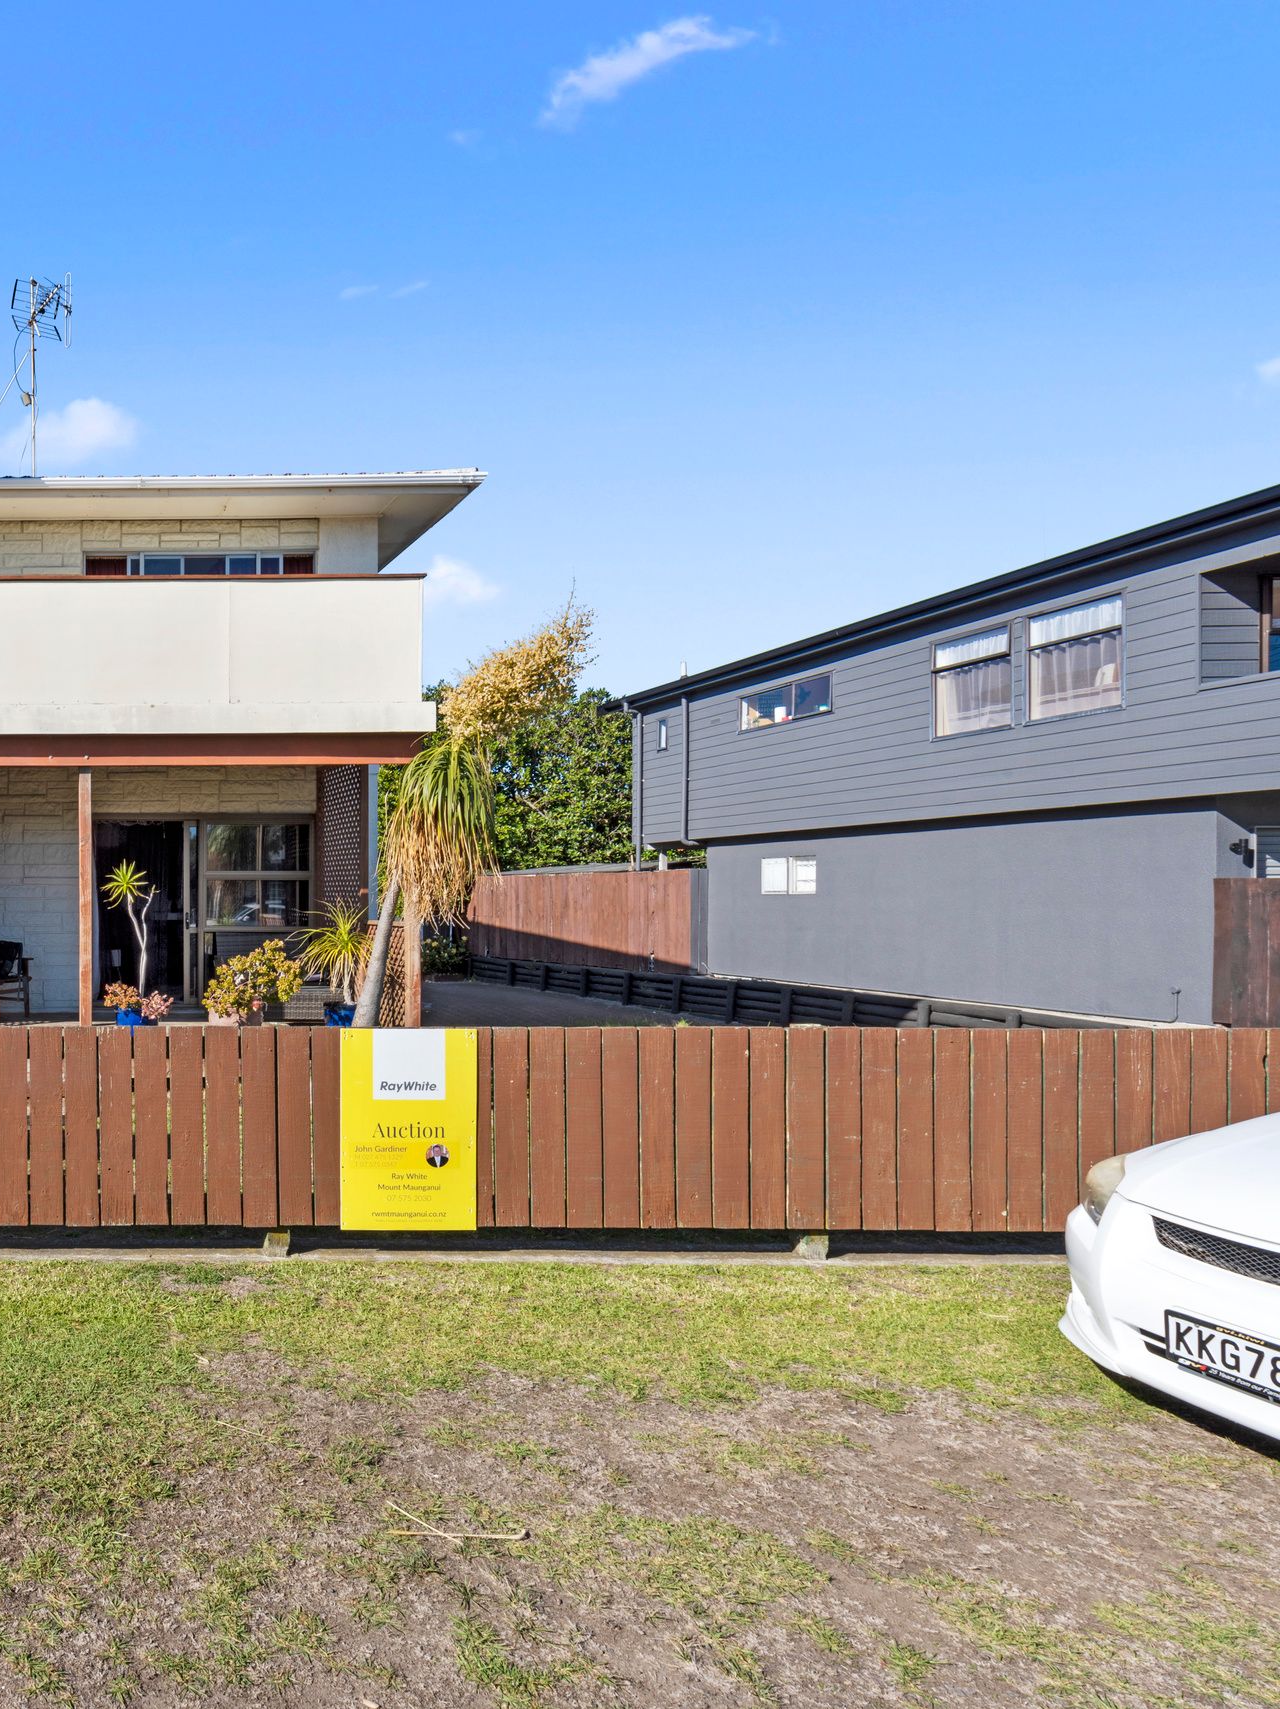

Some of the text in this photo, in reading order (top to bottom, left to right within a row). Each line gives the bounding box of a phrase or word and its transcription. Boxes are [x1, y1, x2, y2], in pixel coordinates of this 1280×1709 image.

[379, 1081, 437, 1093] RayWhite
[372, 1121, 445, 1139] Auction
[354, 1145, 408, 1153] John Gardiner
[391, 1172, 428, 1180] Ray White
[402, 1184, 441, 1192] Maunganui
